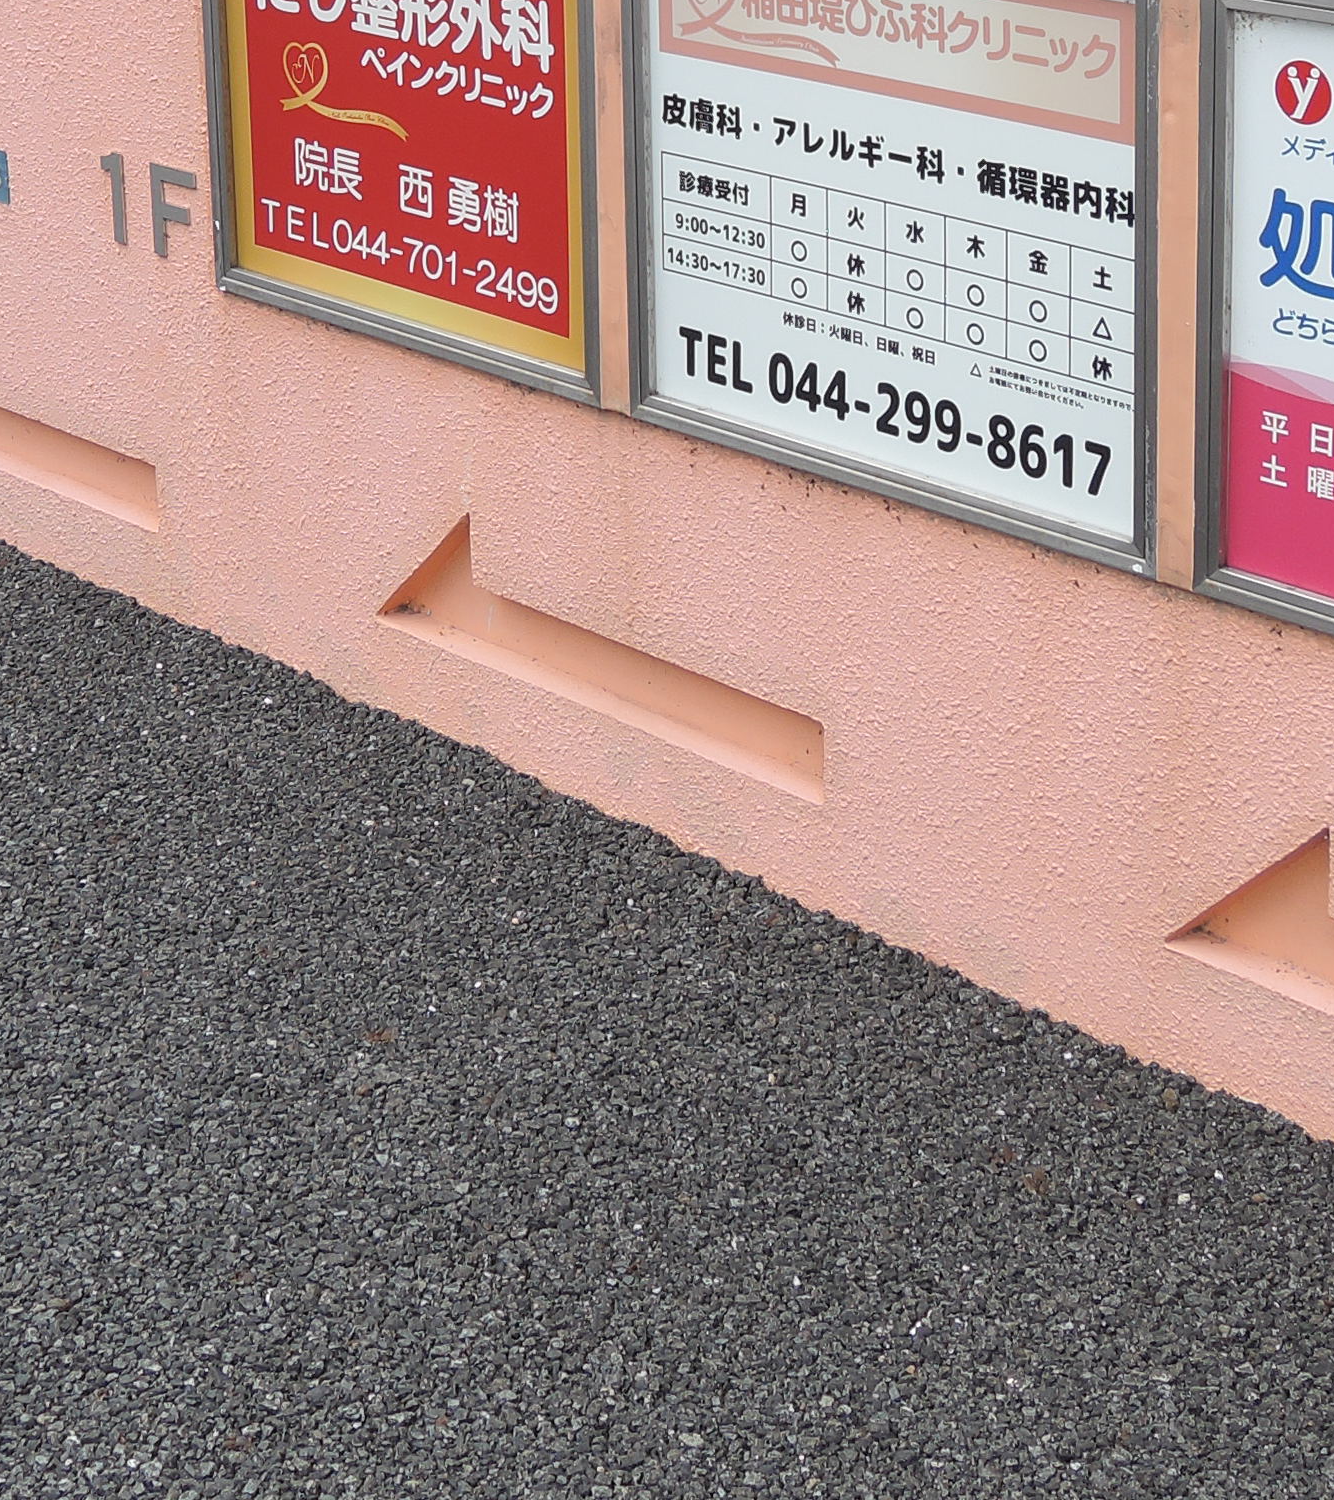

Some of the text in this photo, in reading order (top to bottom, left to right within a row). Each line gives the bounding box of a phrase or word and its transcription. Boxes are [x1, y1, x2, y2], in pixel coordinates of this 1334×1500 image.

[360, 47, 554, 119] ペインクリニック
[100, 152, 198, 259] 1F
[294, 137, 519, 244] 院長 西 勇樹
[661, 93, 1135, 228] 皮膚科・アレルギー科・循環器内科
[675, 213, 865, 277] 9:00~12:30 休
[679, 172, 1113, 292] 診療受付 月 火 水 木 金 土
[667, 247, 1113, 381] 14:30~17:30 休 休
[679, 326, 1112, 498] TEL 044-299-8617
[1260, 410, 1334, 459] 平日
